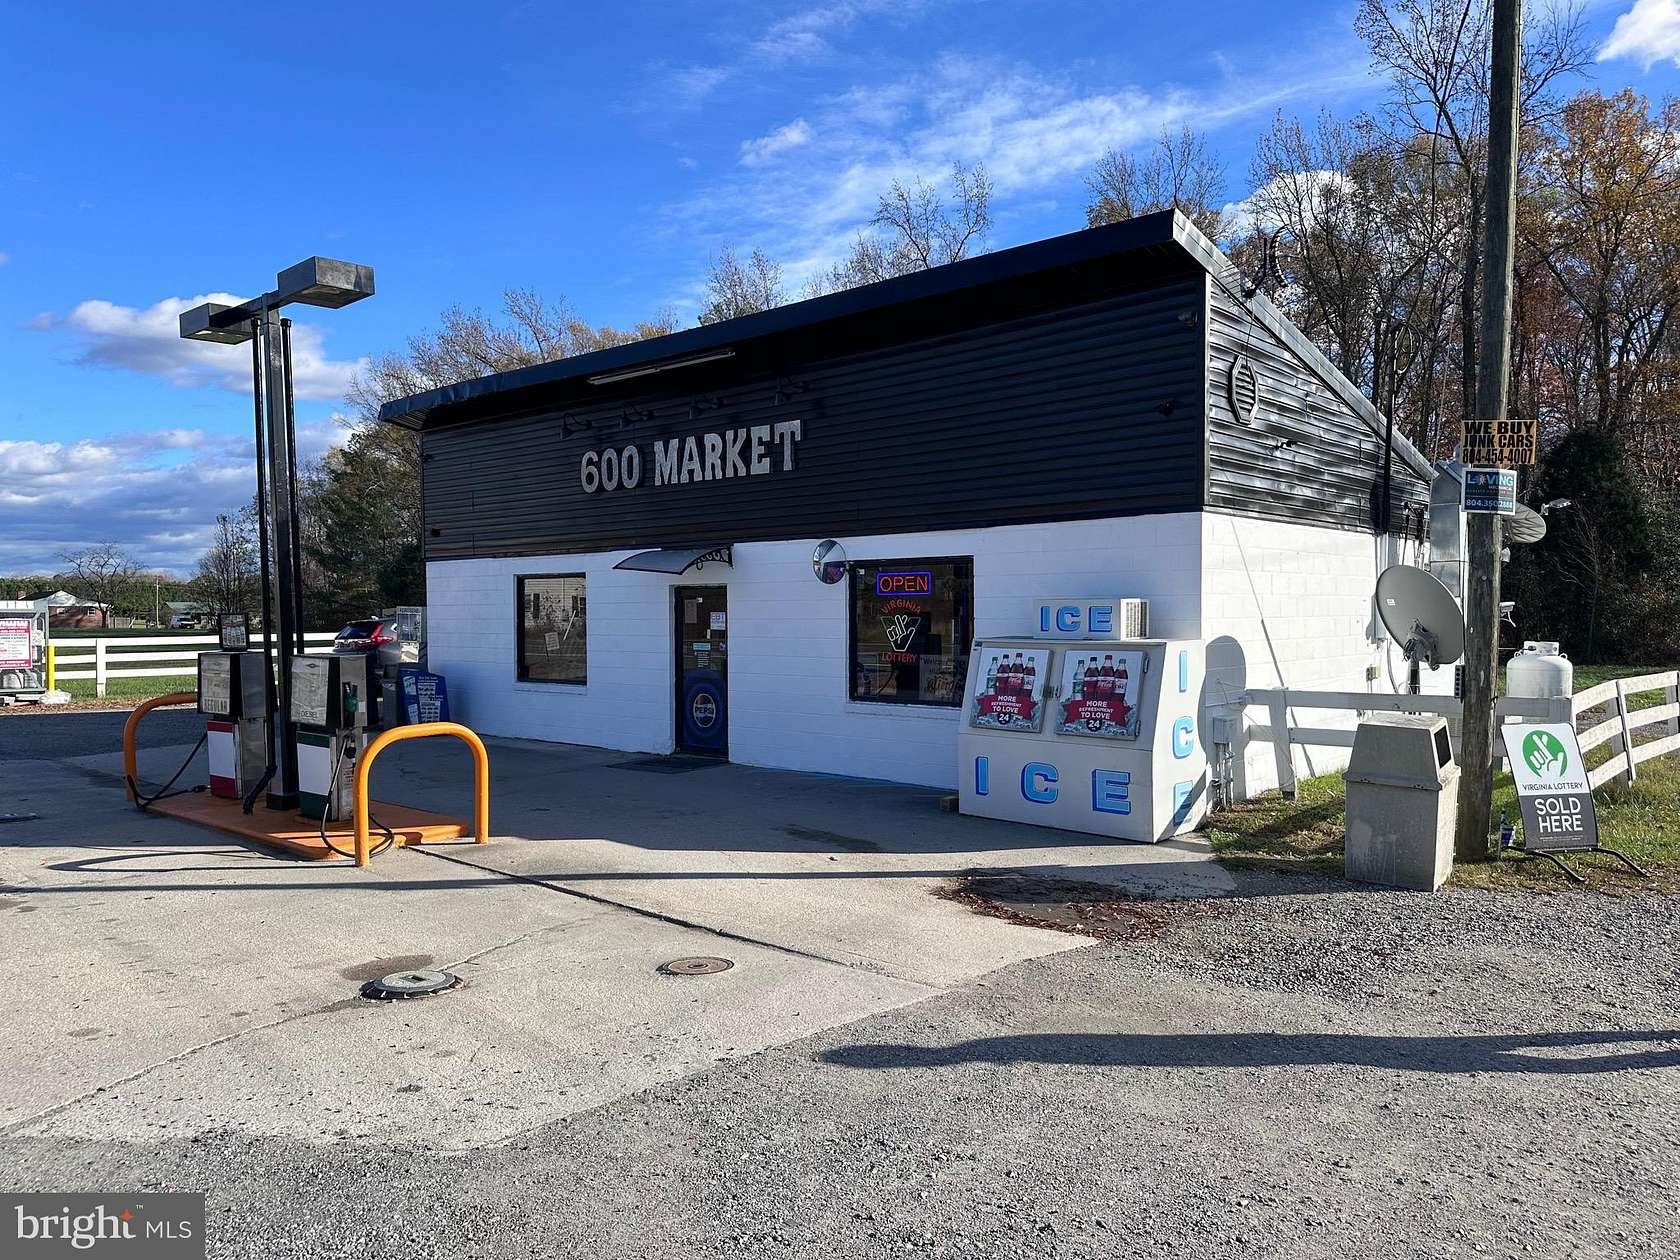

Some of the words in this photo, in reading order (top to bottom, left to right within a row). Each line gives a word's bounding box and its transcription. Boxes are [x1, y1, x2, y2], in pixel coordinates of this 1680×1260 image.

[1464, 421, 1493, 434] WE
[1497, 421, 1535, 434] BUY
[1463, 435, 1495, 448] JUNK
[1498, 435, 1534, 448] CARS
[581, 445, 640, 494] 600
[653, 420, 801, 486] MARKET
[1462, 448, 1533, 464] 804-454-4007
[879, 576, 929, 592] OPEN
[881, 599, 921, 615] VIRGINIA
[1040, 605, 1113, 632] ICE
[881, 652, 919, 664] LOTTERY
[998, 695, 1017, 703] MORE
[1086, 700, 1108, 708] MORE
[1088, 720, 1100, 728] 24
[1091, 712, 1111, 720] LOVE
[1172, 650, 1194, 826] ICE
[975, 755, 1132, 816] ICE
[1522, 782, 1553, 791] VIRGINIA
[1553, 782, 1583, 790] LOTTERY
[1534, 797, 1581, 816] SOLD
[1538, 815, 1583, 833] HERE
